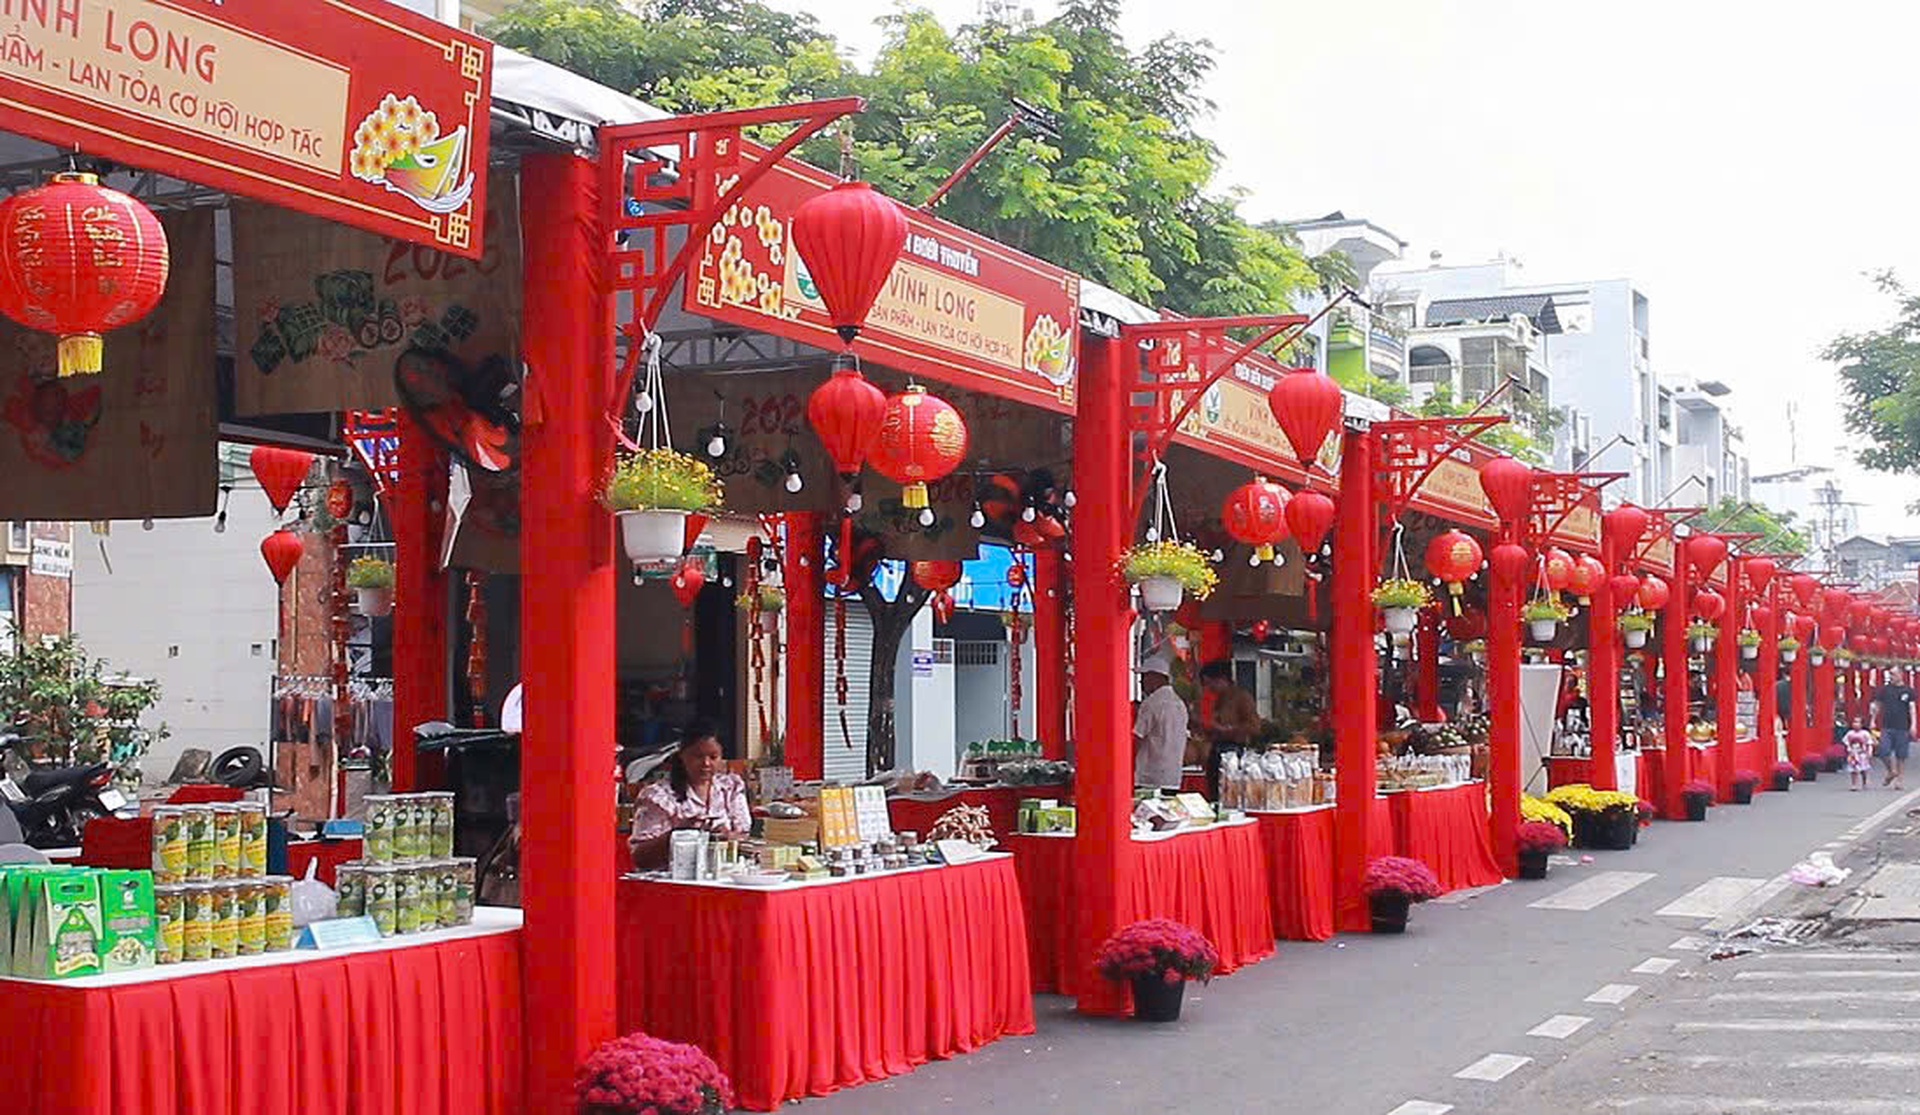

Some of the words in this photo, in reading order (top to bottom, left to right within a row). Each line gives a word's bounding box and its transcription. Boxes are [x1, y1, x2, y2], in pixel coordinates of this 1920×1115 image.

[105, 10, 216, 84] LONG
[69, 58, 111, 92] LAN
[118, 70, 162, 107] TỎA
[169, 92, 198, 117] CƠ
[204, 100, 239, 134] HỘI
[245, 114, 285, 147] HỢP
[291, 127, 322, 158] TÁC
[889, 267, 929, 307] VĨNH
[935, 288, 975, 322] LONG
